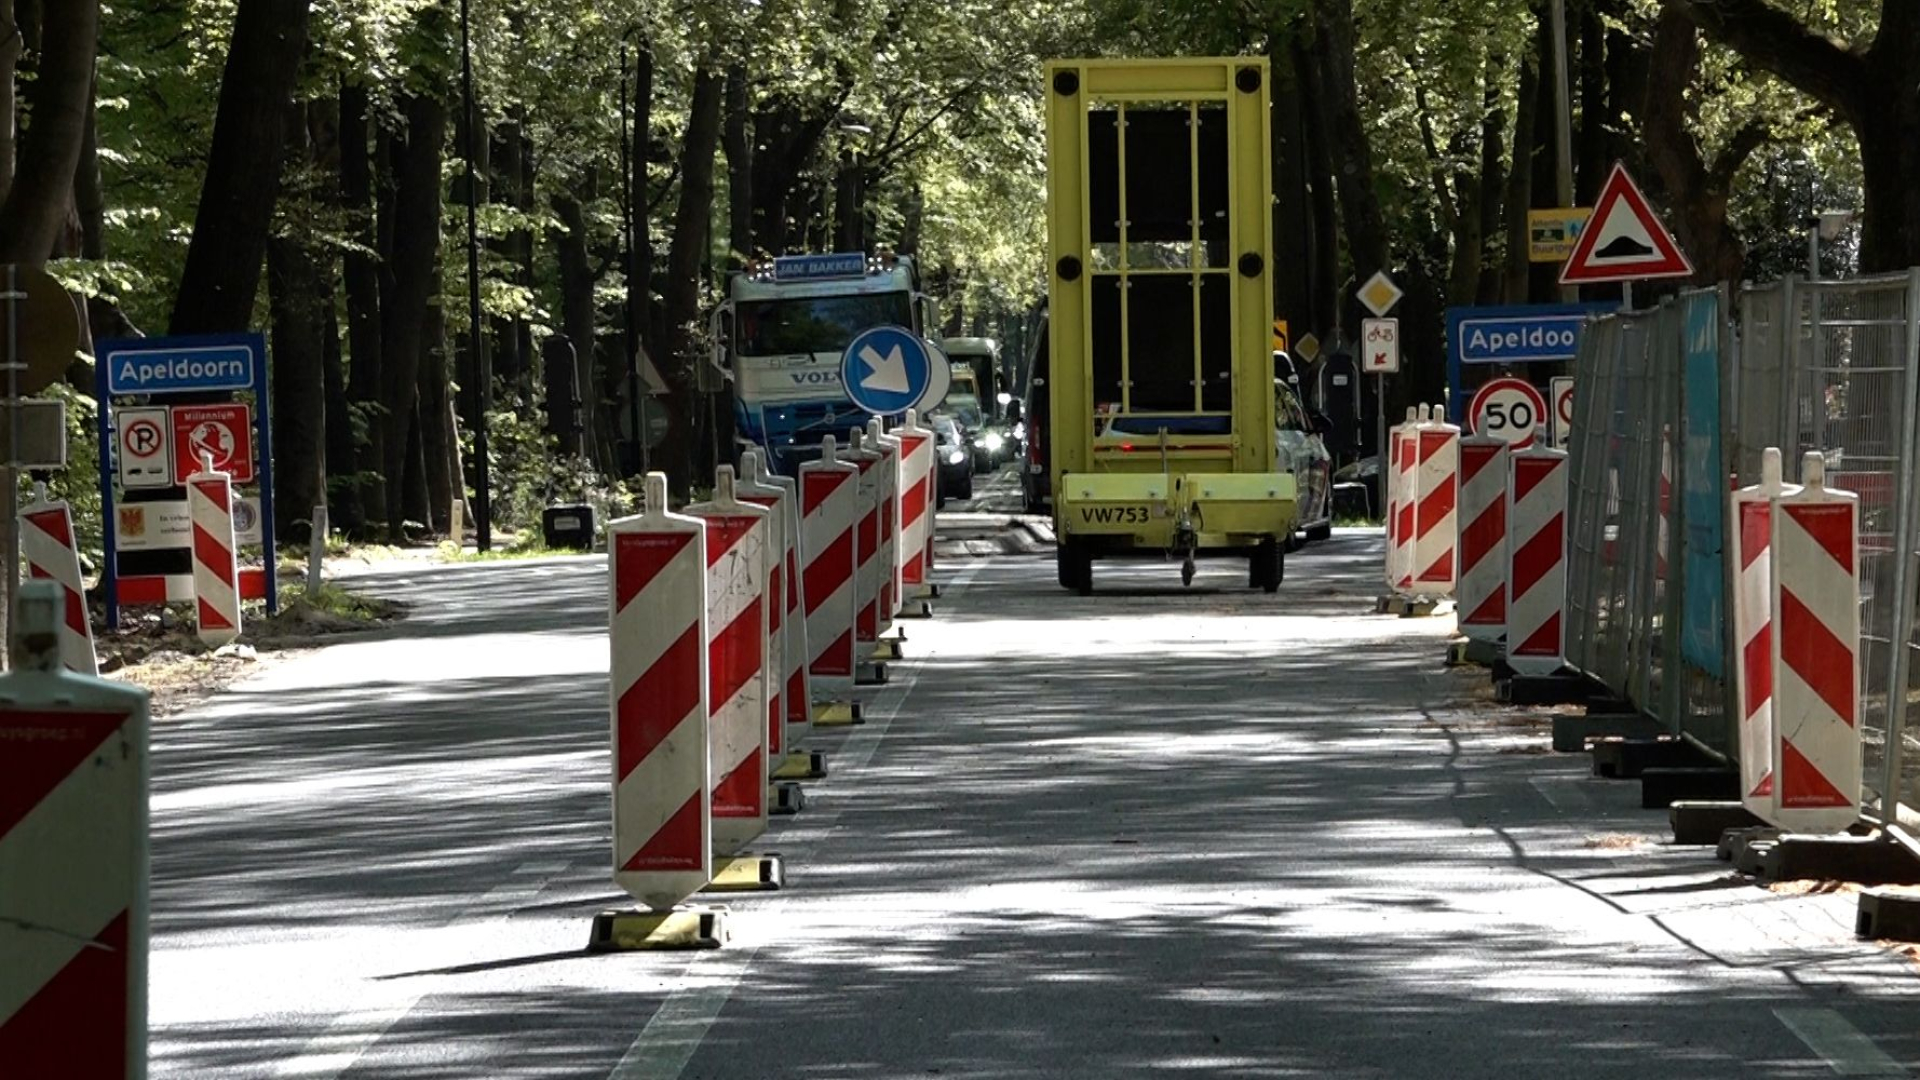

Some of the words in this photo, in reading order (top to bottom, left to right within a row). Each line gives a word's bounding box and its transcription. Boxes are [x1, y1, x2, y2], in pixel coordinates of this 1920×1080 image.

[780, 263, 802, 275] JAN
[809, 260, 861, 273] BAKKER
[1469, 326, 1574, 353] Apeldoo
[119, 358, 243, 385] Apeldoorn
[790, 371, 841, 384] VOL
[1486, 402, 1532, 430] 50
[1081, 507, 1149, 524] VW753
